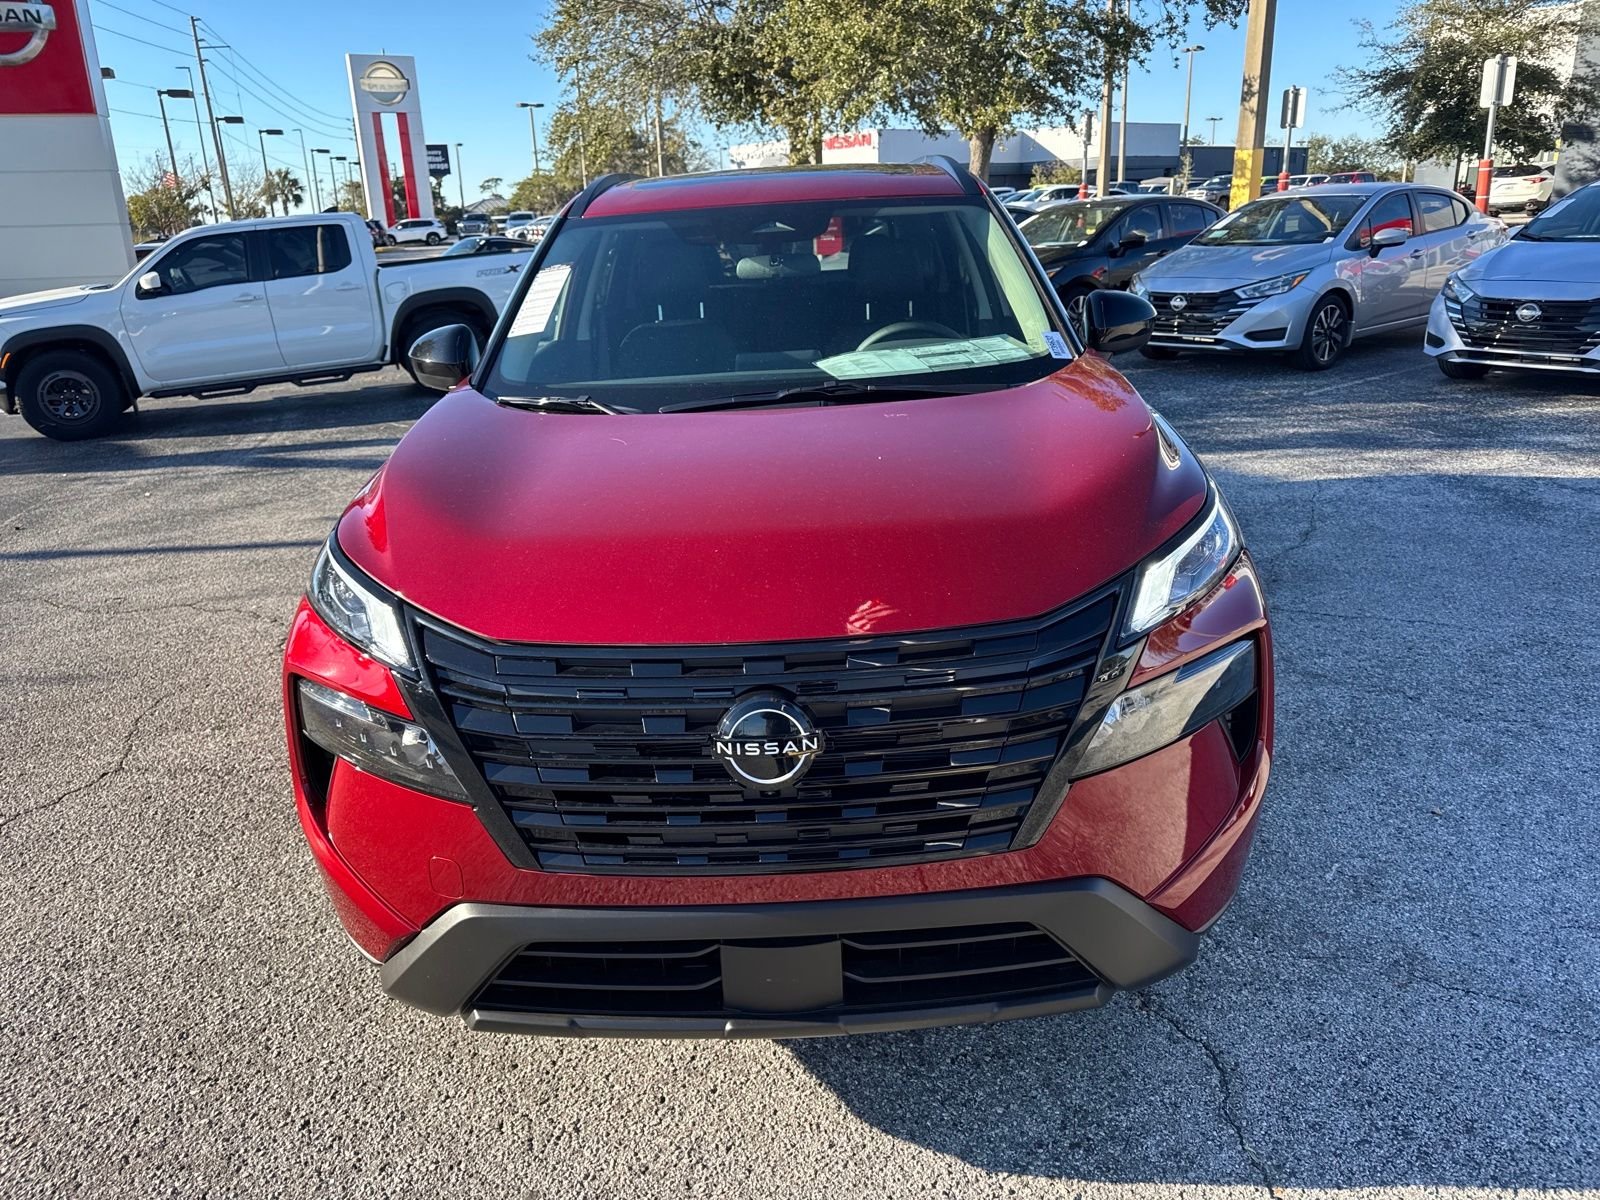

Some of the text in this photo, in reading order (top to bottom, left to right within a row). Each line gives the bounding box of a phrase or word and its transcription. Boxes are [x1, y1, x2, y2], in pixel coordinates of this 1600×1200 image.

[0, 9, 43, 24] AN
[825, 132, 872, 150] NISSAN
[716, 737, 818, 756] NISSAN
